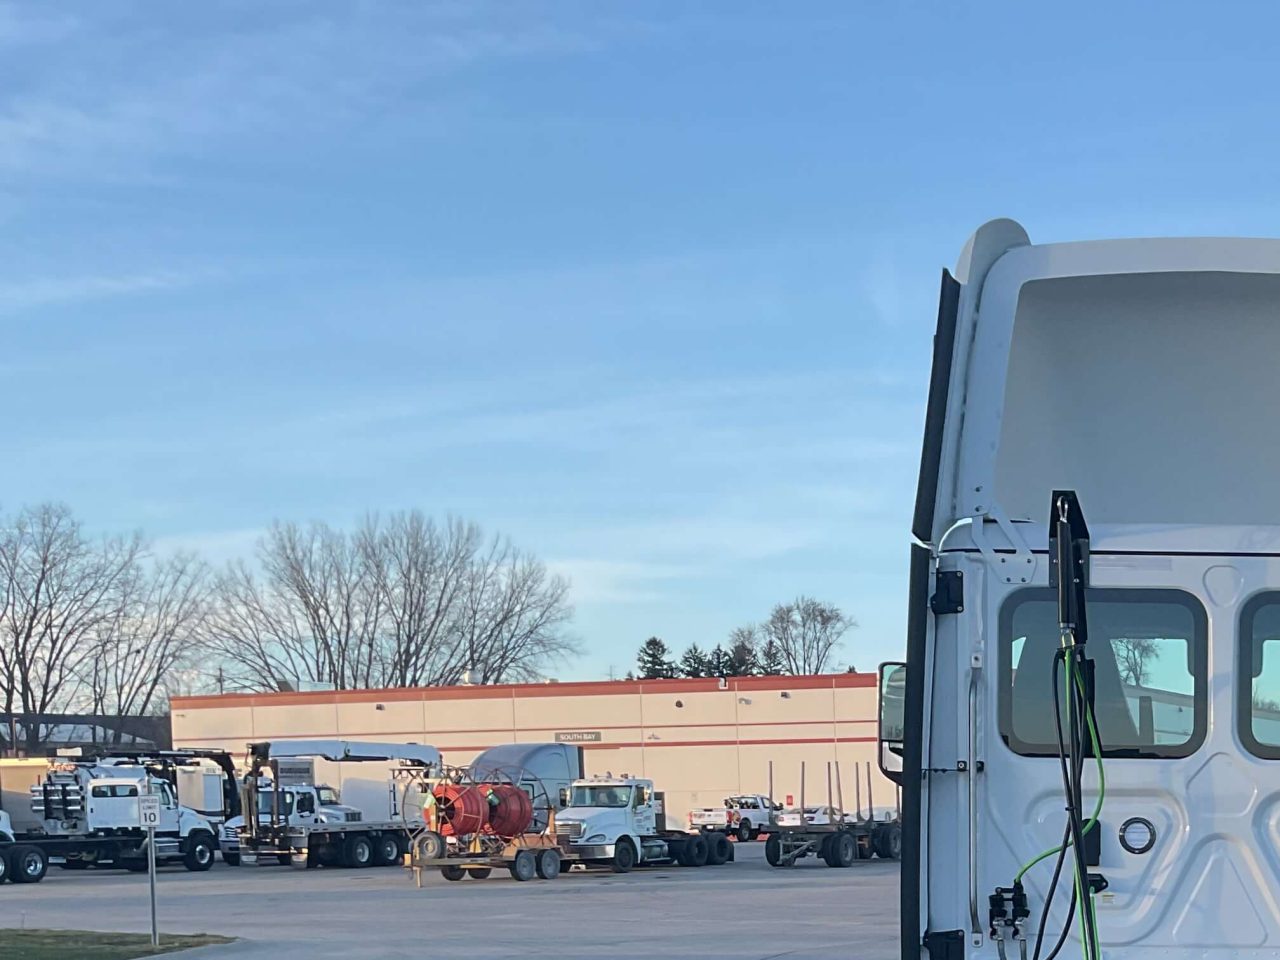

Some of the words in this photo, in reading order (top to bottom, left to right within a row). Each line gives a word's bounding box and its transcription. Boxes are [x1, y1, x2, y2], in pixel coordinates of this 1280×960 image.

[560, 733, 583, 741] SOUTH
[584, 732, 596, 740] BAY
[143, 812, 157, 823] 10
